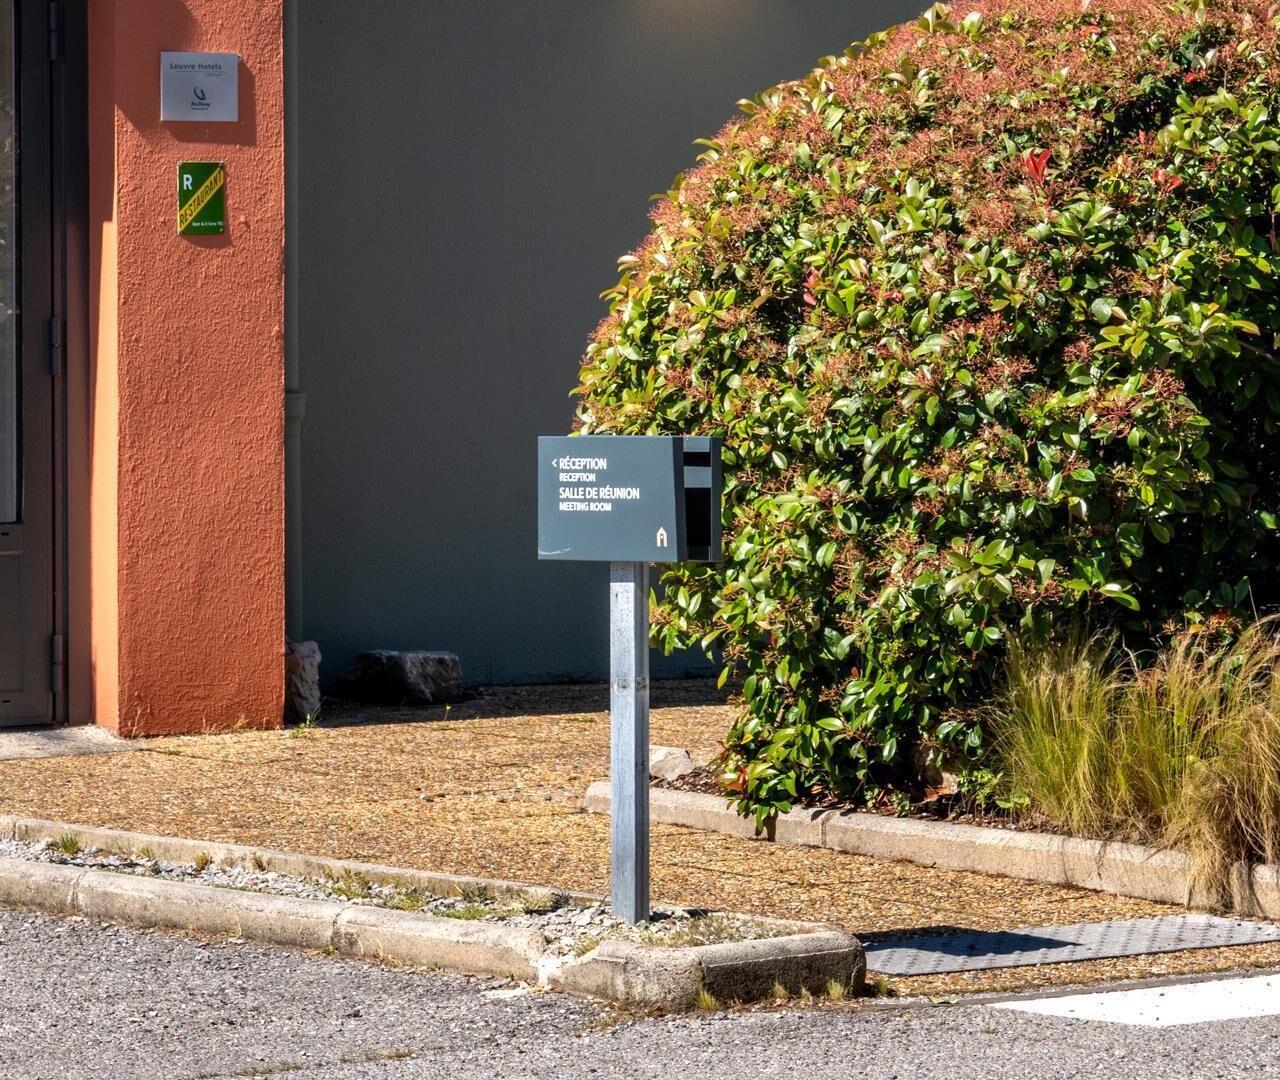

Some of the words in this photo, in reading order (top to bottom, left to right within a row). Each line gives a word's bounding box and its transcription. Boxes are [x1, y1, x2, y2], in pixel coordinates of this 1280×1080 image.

[198, 63, 223, 71] Hotels
[183, 174, 193, 190] R
[180, 169, 224, 226] RESTAURANT
[559, 455, 607, 470] RÉCEPTION
[559, 472, 596, 482] RECEPTION
[559, 487, 585, 499] SALLE
[585, 487, 598, 499] DE
[599, 484, 640, 499] RÉUNION
[559, 501, 589, 511] MEETING
[590, 502, 612, 511] ROOM
